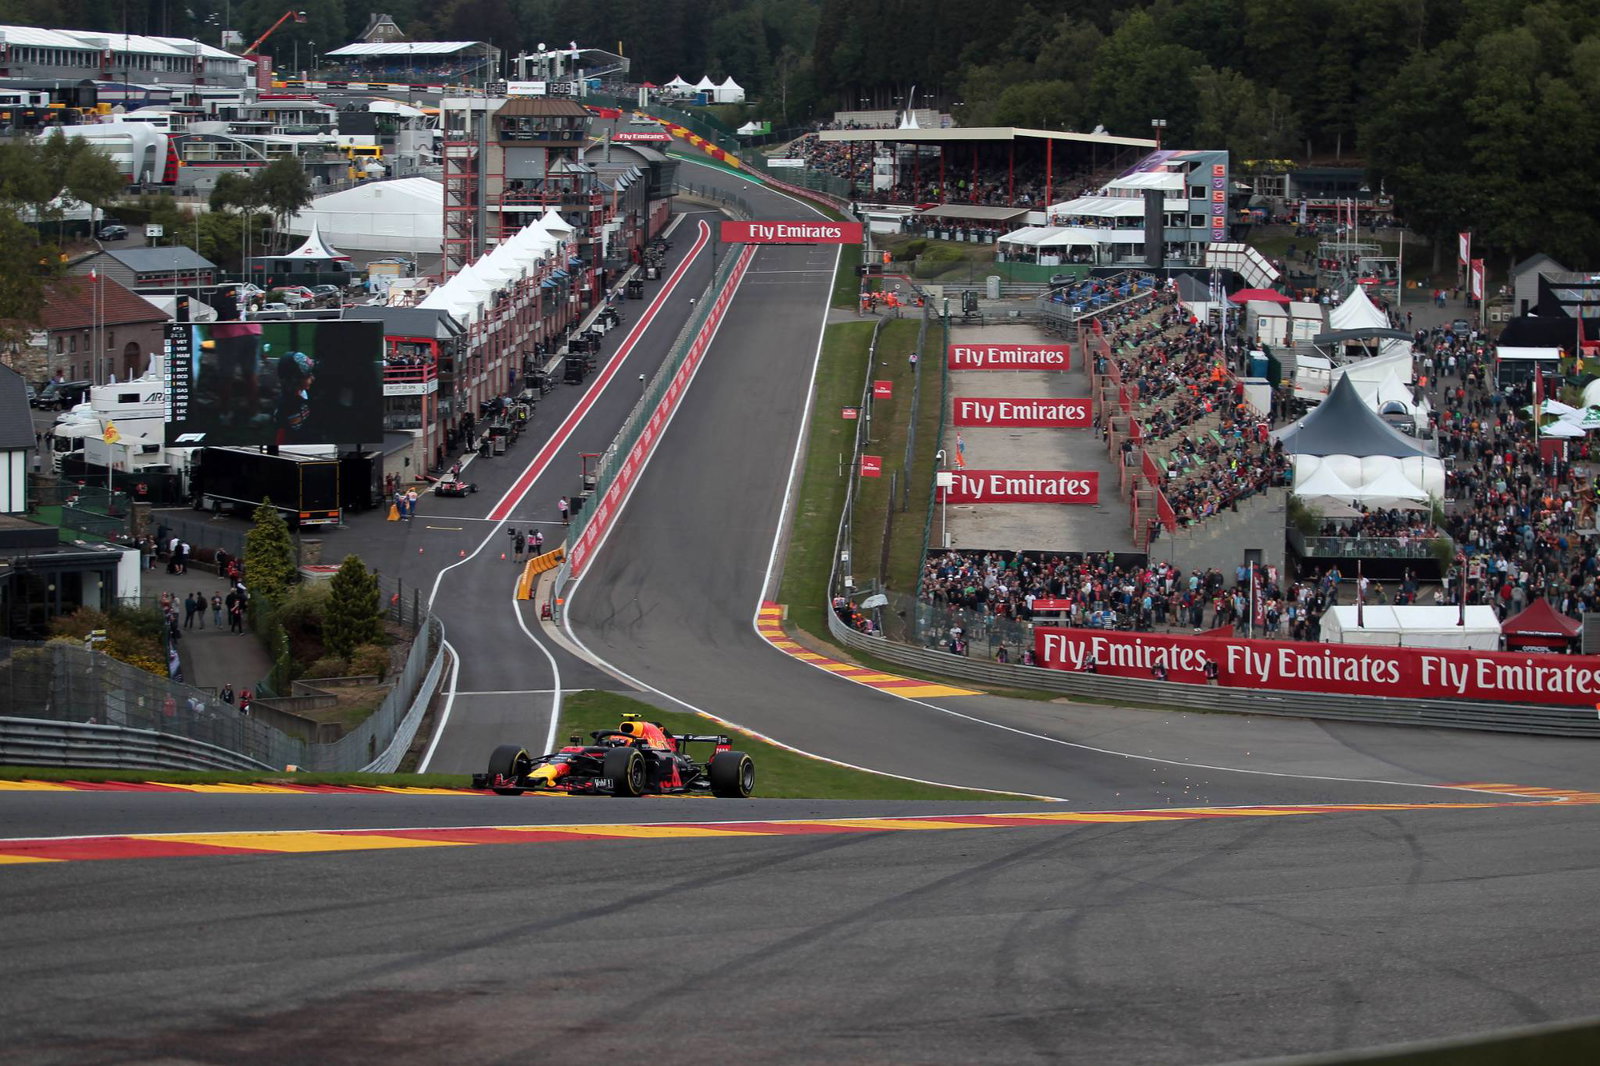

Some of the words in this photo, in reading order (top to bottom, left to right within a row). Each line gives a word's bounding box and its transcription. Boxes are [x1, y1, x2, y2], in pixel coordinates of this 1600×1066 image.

[749, 224, 775, 240] Fly
[777, 224, 841, 238] Emirates
[954, 348, 984, 367] Fly
[987, 347, 1064, 364] Emirates
[961, 401, 995, 423] Fly
[998, 401, 1086, 420] Emirates
[946, 474, 985, 499] Fly
[990, 474, 1091, 496] Emirates
[1043, 634, 1086, 670] Fly
[1091, 636, 1207, 672] Emirates
[1227, 645, 1272, 682] Fly
[1278, 648, 1400, 684] Emirates
[1420, 655, 1469, 694] Fly
